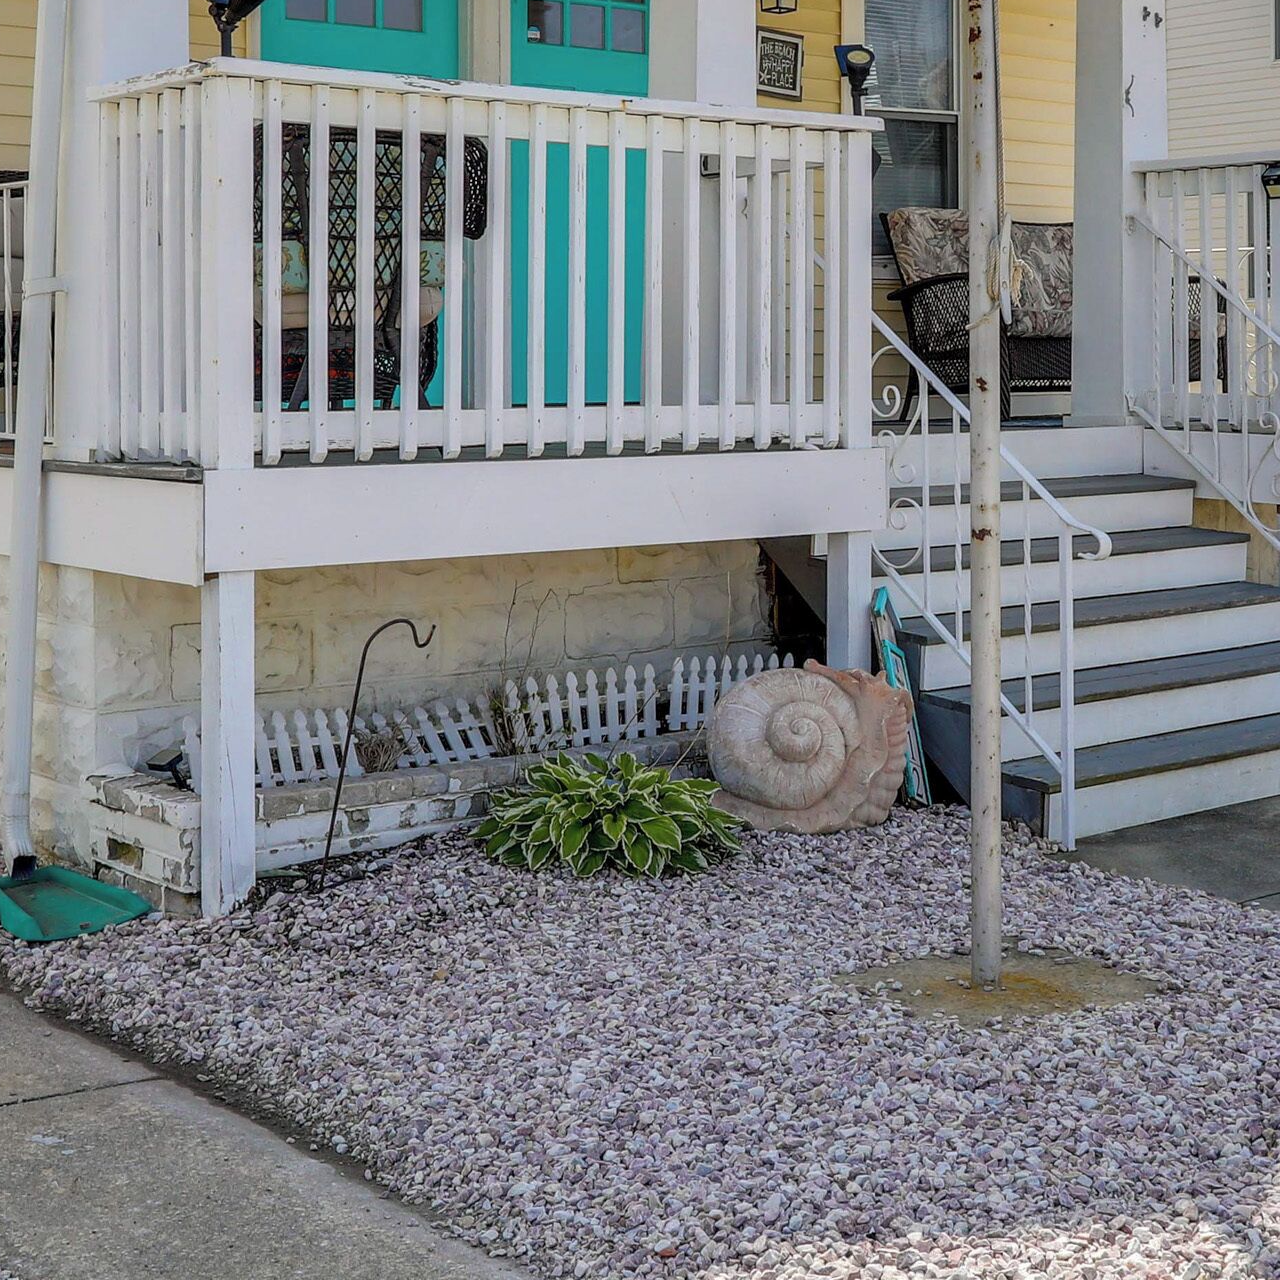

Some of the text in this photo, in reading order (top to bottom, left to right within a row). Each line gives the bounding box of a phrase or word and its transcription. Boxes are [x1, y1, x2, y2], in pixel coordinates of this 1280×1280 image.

[760, 41, 795, 61] THE BEACH
[772, 58, 795, 74] HAPPY
[771, 72, 794, 88] PLACE
